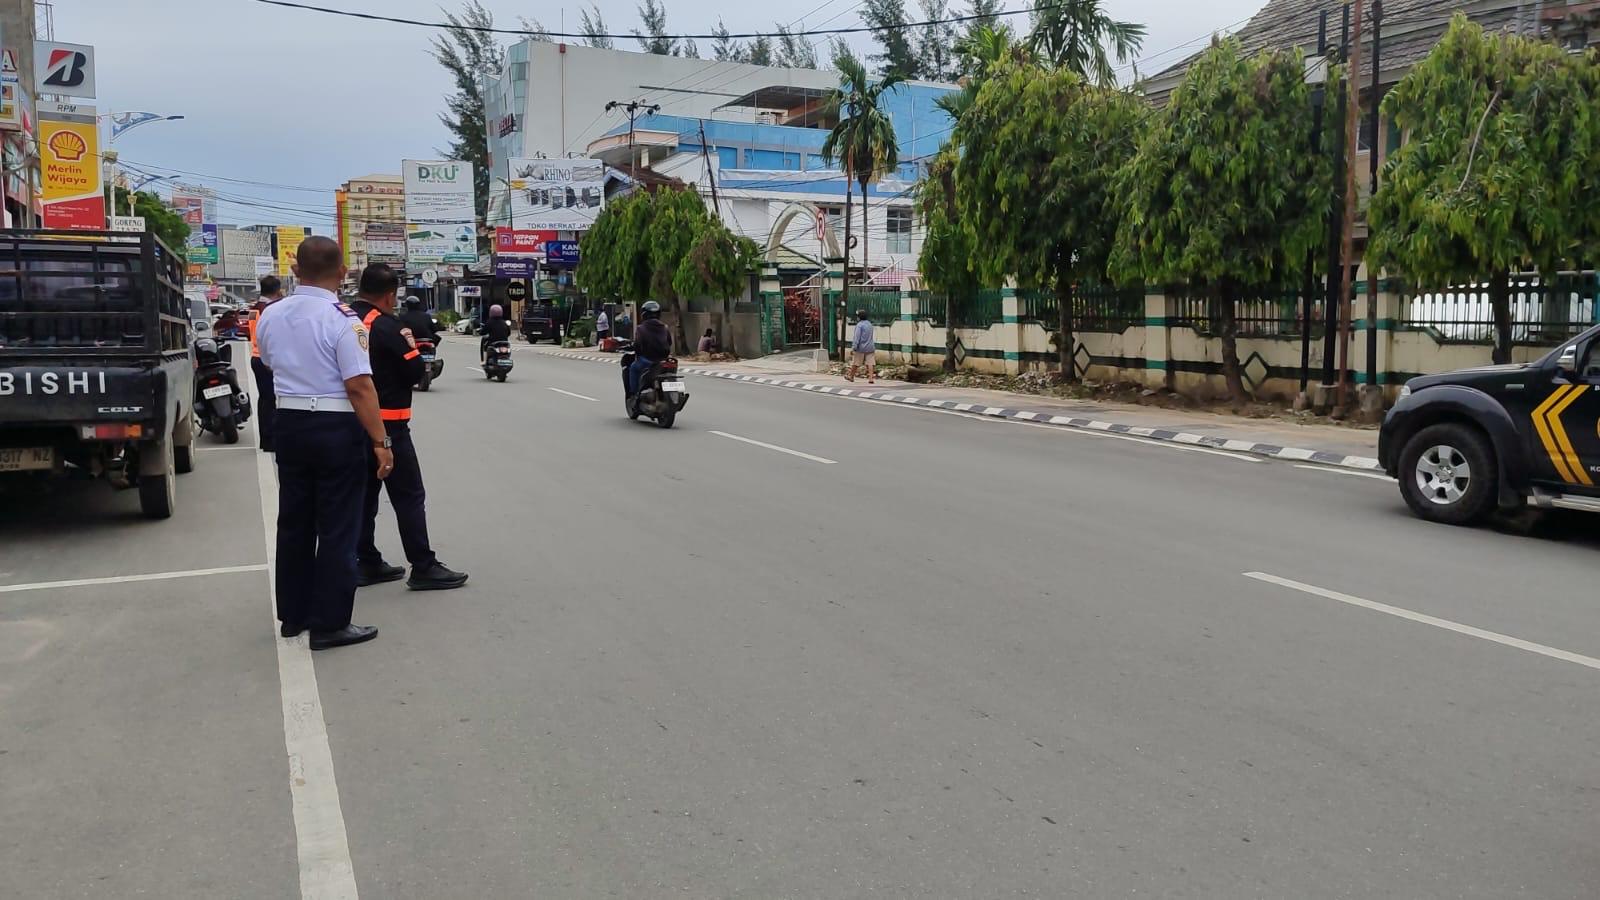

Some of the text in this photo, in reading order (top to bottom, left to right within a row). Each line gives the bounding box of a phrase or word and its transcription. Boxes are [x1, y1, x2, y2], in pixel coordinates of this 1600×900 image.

[57, 104, 77, 113] RPM
[47, 164, 82, 174] Merlin
[47, 174, 87, 184] Wijaya
[544, 168, 571, 181] RHINO
[527, 222, 547, 230] TOKO
[548, 222, 577, 230] BERKAT
[462, 286, 480, 294] JNE
[0, 371, 106, 395] BISHI
